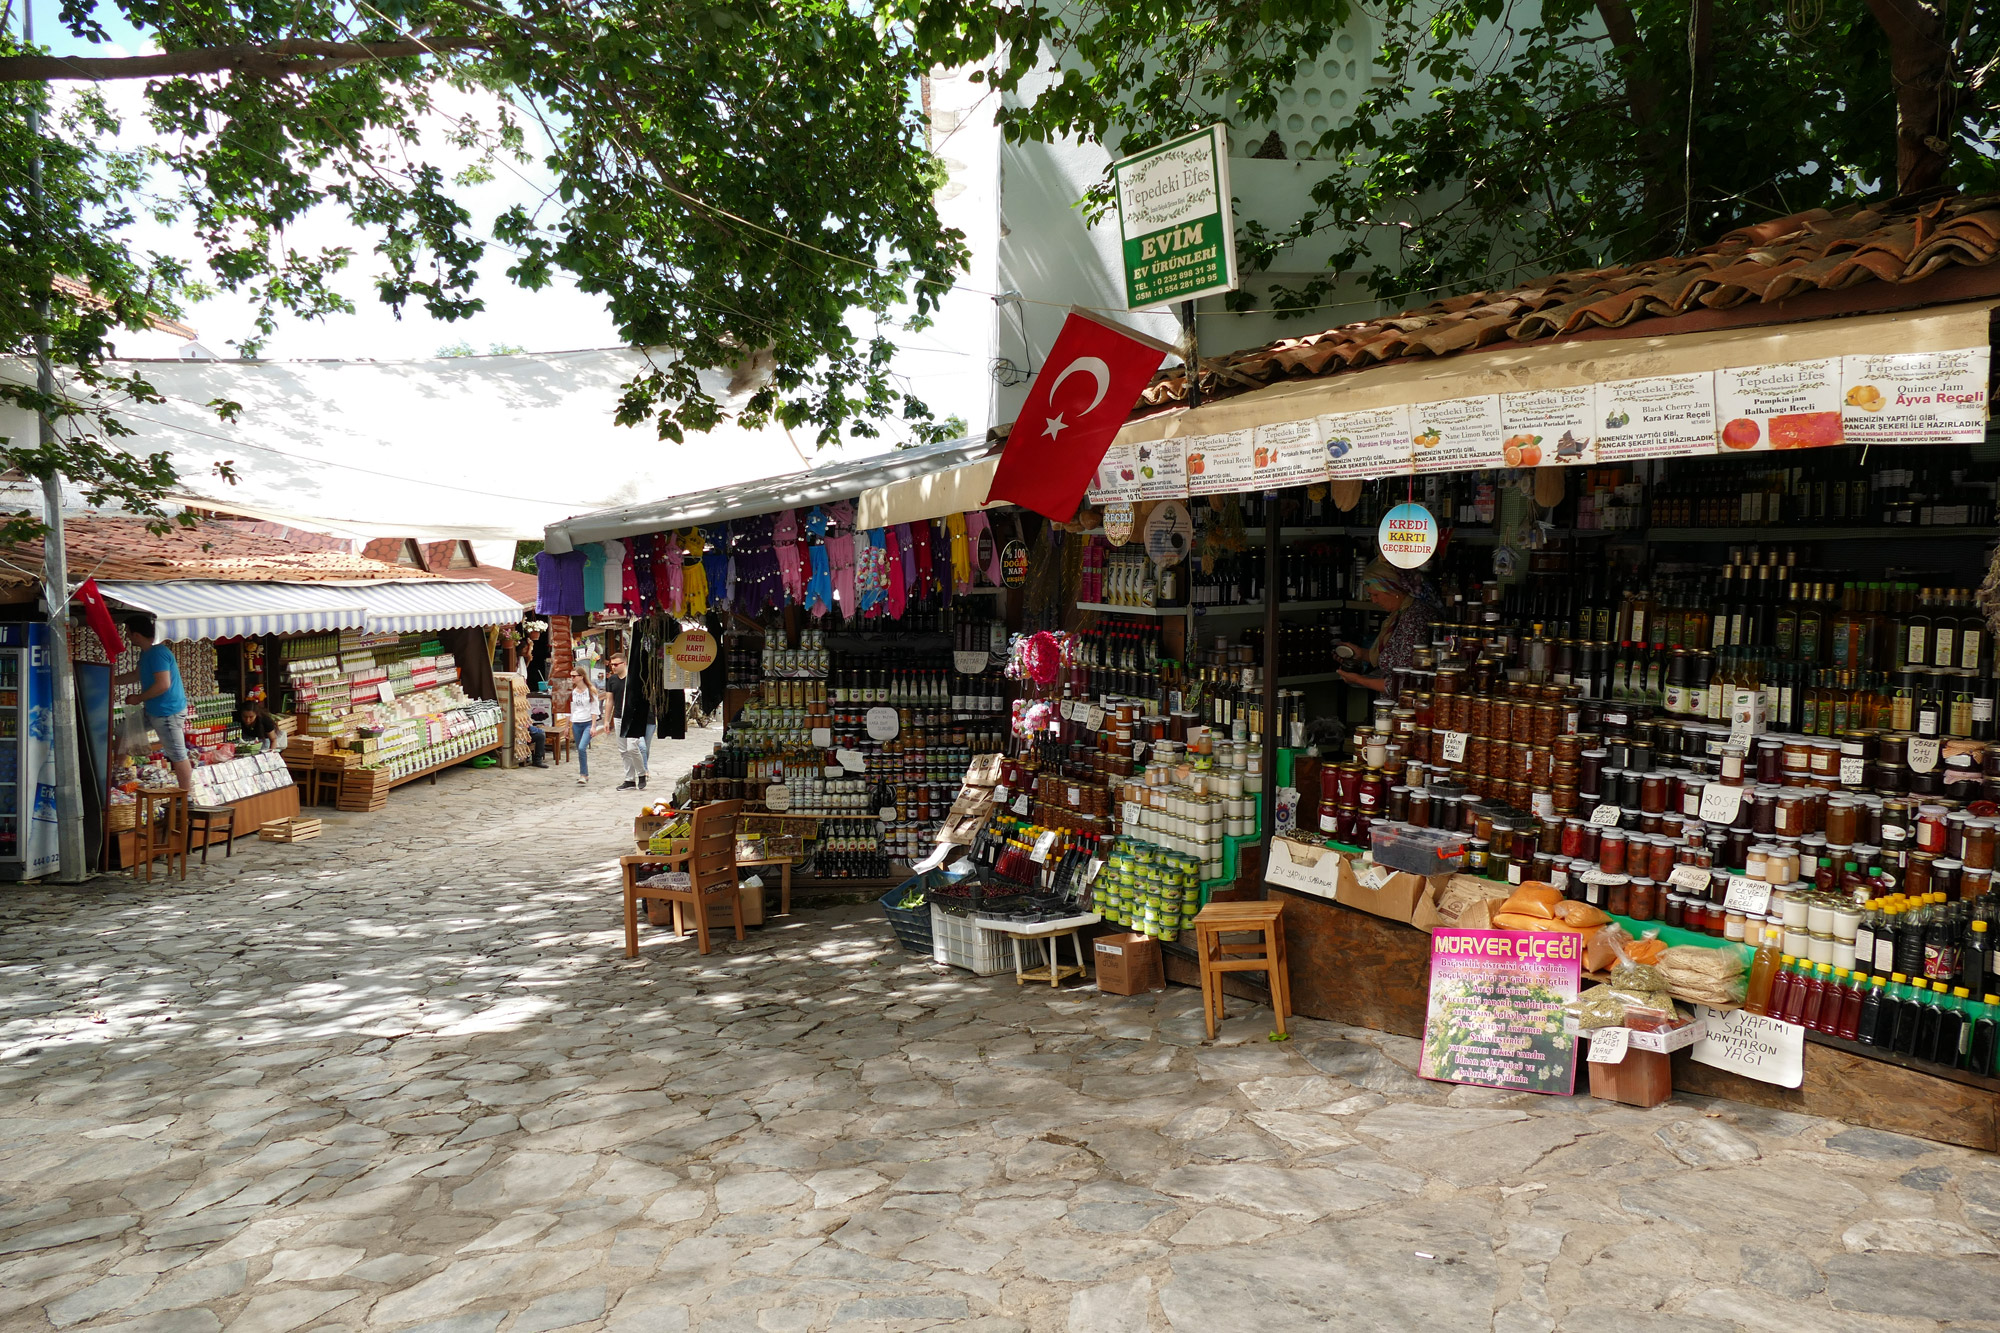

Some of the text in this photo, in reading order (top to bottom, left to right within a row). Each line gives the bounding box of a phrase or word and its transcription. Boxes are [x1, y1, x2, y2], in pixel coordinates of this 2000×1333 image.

[1125, 167, 1209, 207] Tepedeki Efes
[1141, 223, 1203, 260] EVİM
[1134, 244, 1217, 280] EV ÜRÜNLERİ
[1135, 283, 1148, 291] TEL
[1164, 273, 1177, 284] 232
[1179, 270, 1193, 279] 898
[1195, 266, 1204, 275] 31
[1207, 263, 1216, 272] 38
[1135, 292, 1151, 301] GSM
[1165, 283, 1178, 293] 554
[1180, 279, 1193, 288] 281
[1196, 276, 1205, 285] 99
[1207, 273, 1217, 282] 95
[1865, 360, 1968, 373] Tepedeki Efes
[1736, 372, 1825, 387] Tepedeki Efes
[1613, 386, 1665, 396] Tepedeki
[1897, 383, 1964, 394] Quince Jam
[1506, 395, 1585, 408] Tepedeki Efes
[1754, 397, 1790, 405] Pumpkin
[1896, 392, 1983, 406] Ayva Reçeli
[1420, 408, 1462, 418] Tepedeki
[1790, 404, 1815, 412] Reçeli
[1686, 411, 1711, 419] Reçeli
[1844, 415, 1884, 423] ANNENİZİN
[1330, 418, 1371, 428] Tepedeki
[1878, 423, 1908, 431] ŞEKERİ
[1265, 430, 1294, 439] Tepedeki
[1482, 429, 1499, 437] Reçeli
[1663, 430, 1678, 438] GİBİ,
[1670, 435, 1715, 444] HAZIRLADIK.
[1105, 512, 1132, 524] REÇELİ
[1389, 518, 1428, 530] KREDİ
[1390, 532, 1425, 541] KARTI
[1014, 548, 1026, 558] 100
[1383, 544, 1431, 554] GEÇERLİDİR
[687, 634, 706, 642] KREDİ
[677, 654, 712, 663] GEÇERLİDİR
[1705, 794, 1738, 808] ROSE
[1701, 810, 1726, 822] JAM
[33, 857, 44, 866] 444
[1273, 865, 1284, 875] EV
[1746, 883, 1768, 891] YAPIMI
[1435, 935, 1577, 962] MÜRVER ÇİÇEĞİ
[1707, 1010, 1790, 1035] EV YAPIMI
[1722, 1023, 1758, 1040] SARI
[1706, 1029, 1778, 1056] KANTARON
[1724, 1045, 1762, 1066] YAĞI
